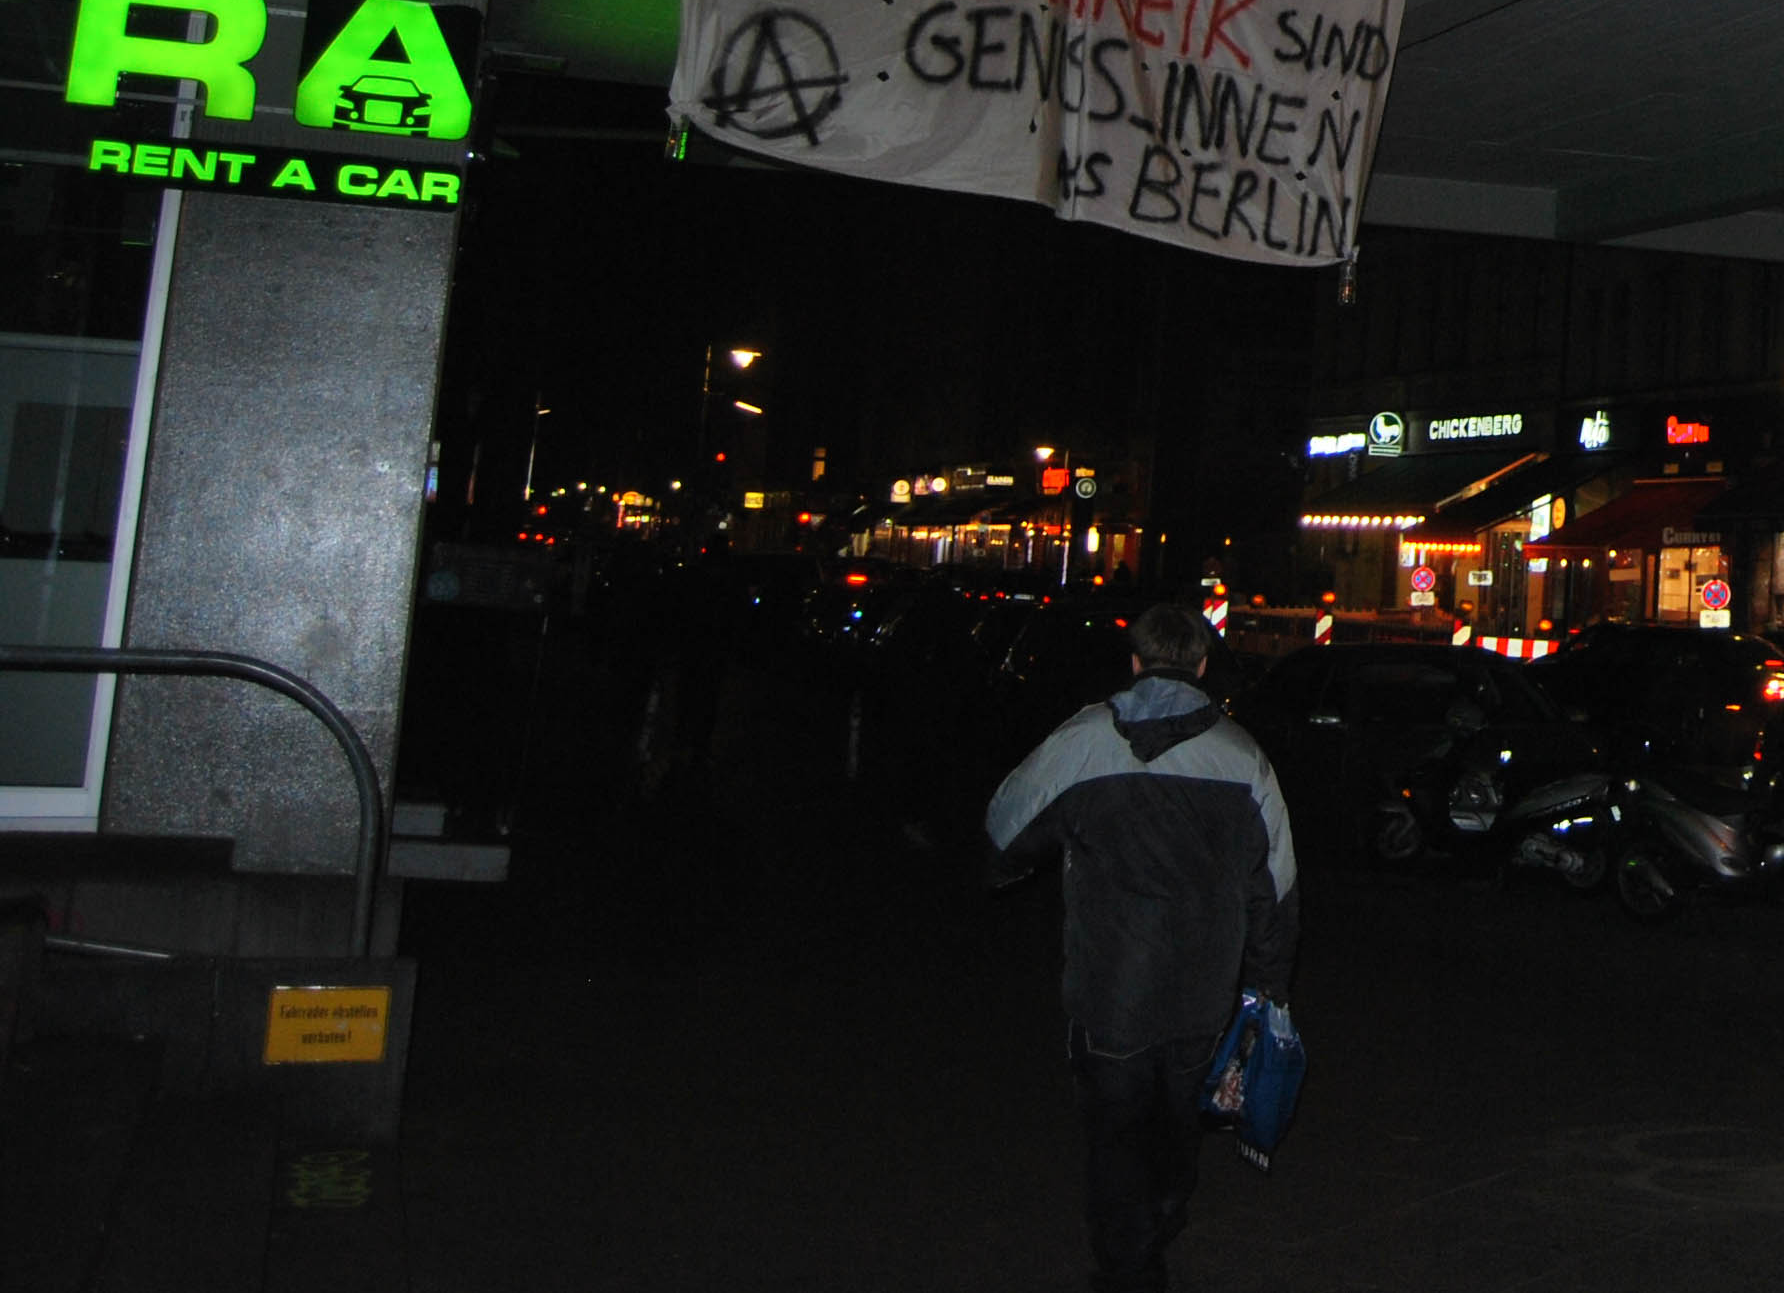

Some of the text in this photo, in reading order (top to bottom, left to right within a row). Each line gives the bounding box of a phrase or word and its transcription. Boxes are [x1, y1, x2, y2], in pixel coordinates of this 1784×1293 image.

[1272, 8, 1391, 84] SIND
[87, 138, 462, 205] RENT A CAR
[1128, 147, 1355, 260] BERLIN
[1428, 414, 1523, 440] CHICKENBERG
